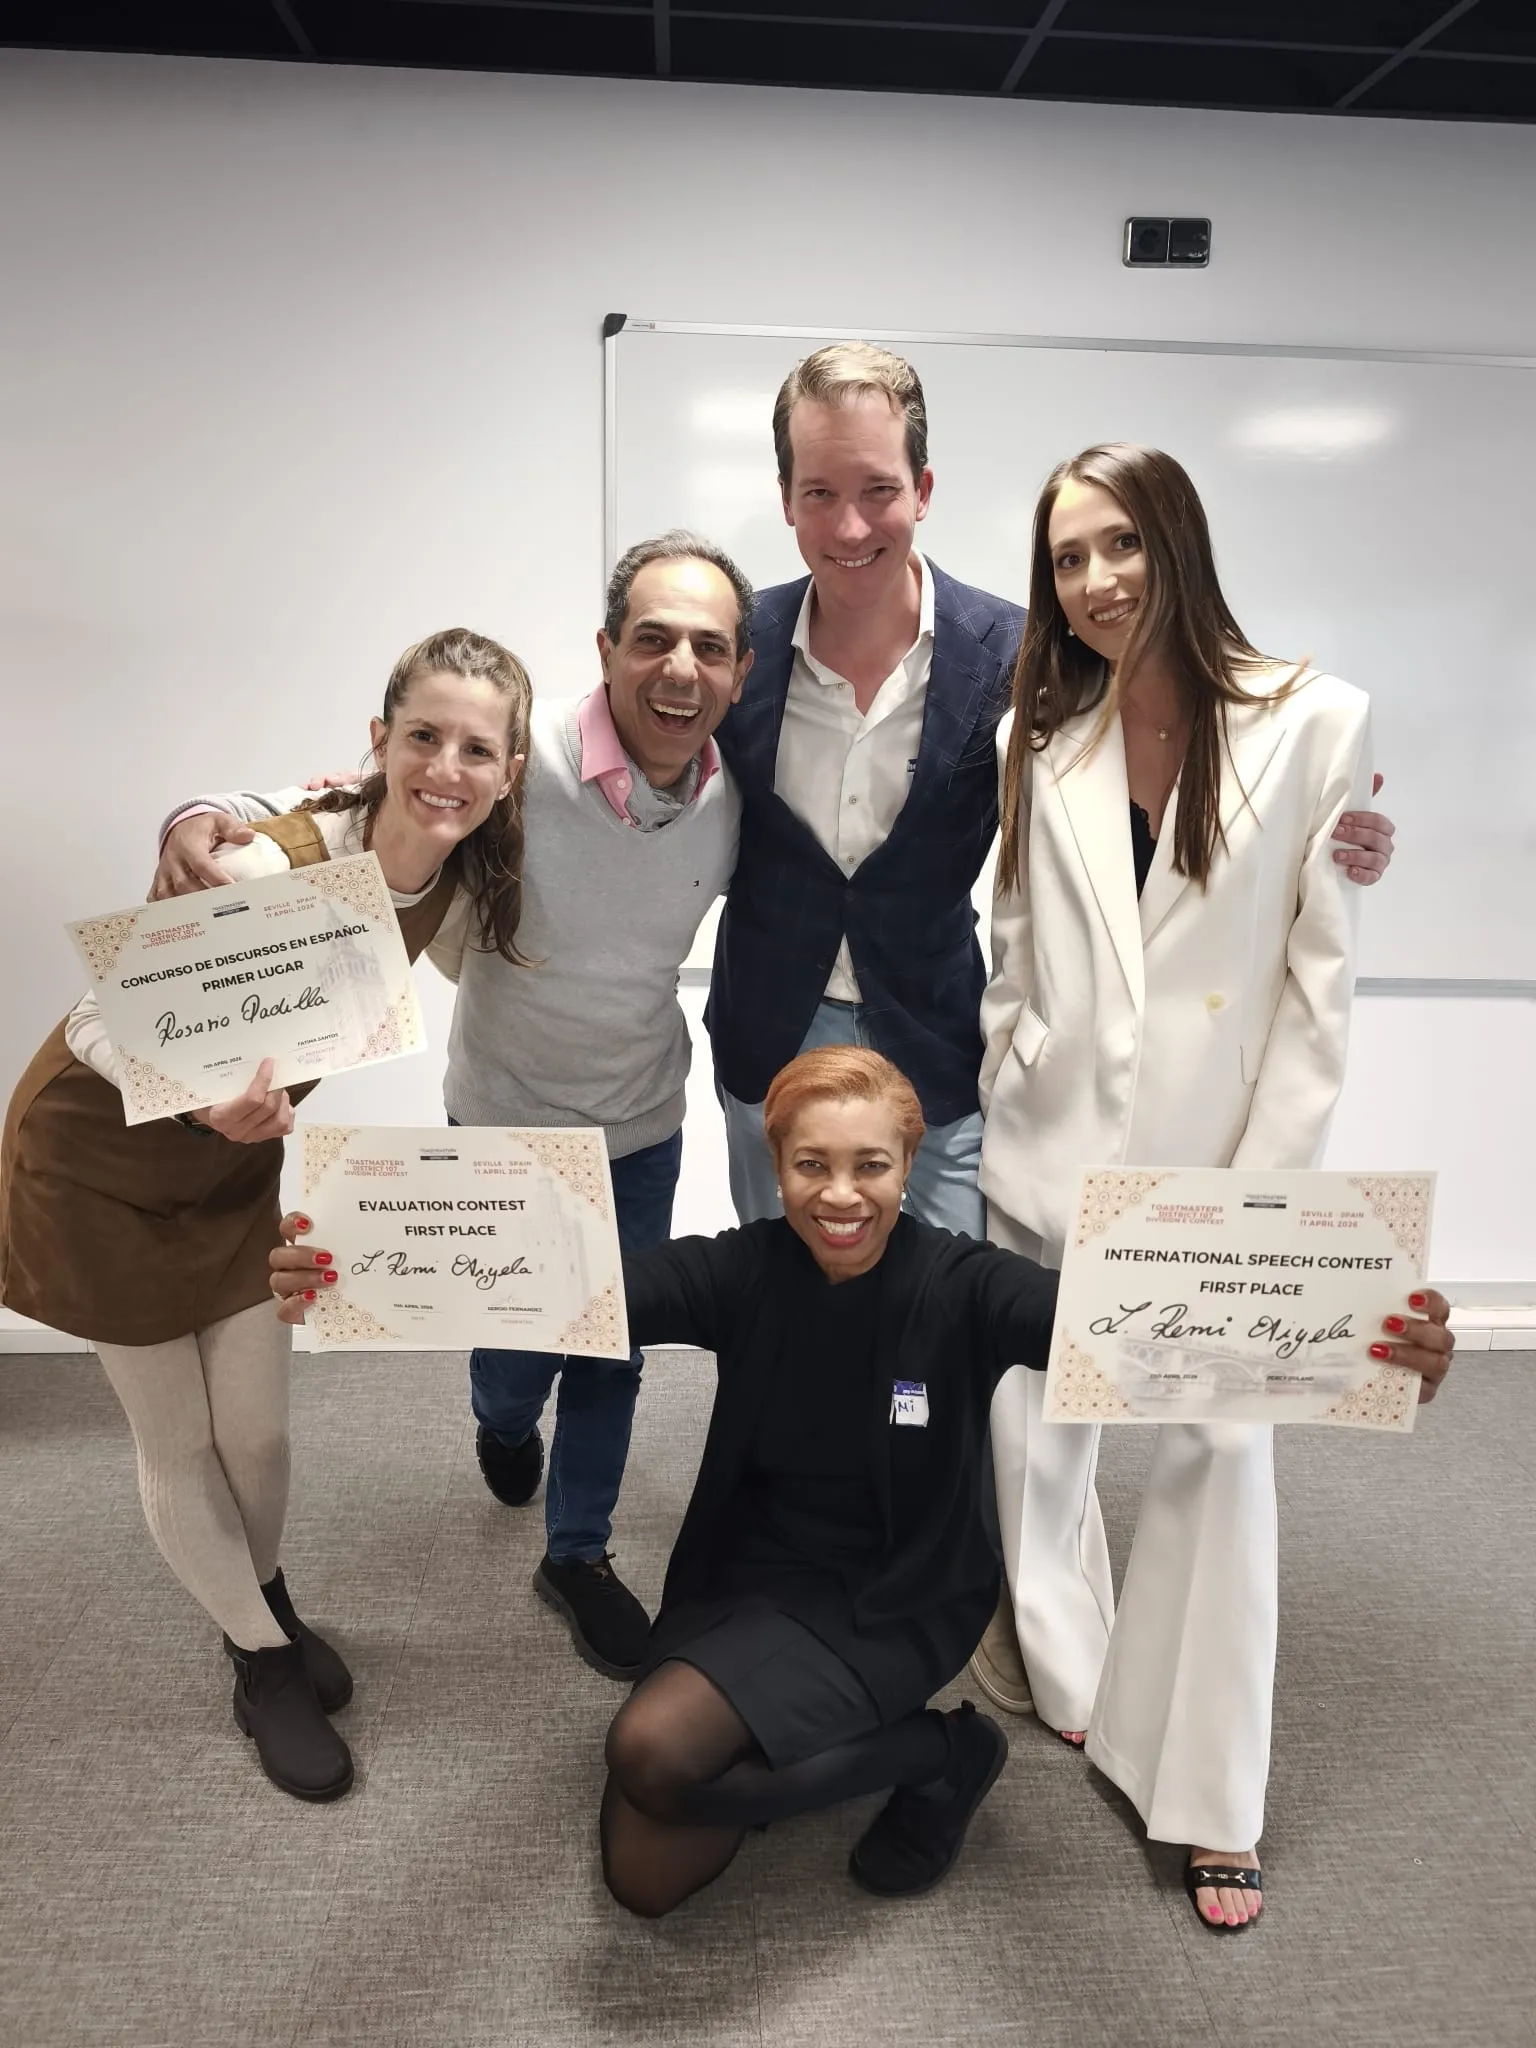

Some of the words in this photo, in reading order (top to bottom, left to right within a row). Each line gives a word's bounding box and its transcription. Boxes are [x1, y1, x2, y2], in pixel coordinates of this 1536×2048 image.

[263, 902, 290, 912] SEVILLE
[273, 908, 296, 918] APRIL
[140, 921, 201, 940] TOASTMASTERS
[150, 932, 181, 943] DISTRICT
[183, 928, 195, 936] 107
[177, 930, 206, 942] CONTEST
[121, 964, 193, 989] CONCURSO
[195, 960, 213, 972] DE
[214, 942, 288, 968] DISCURSOS
[289, 937, 308, 950] EN
[309, 923, 370, 945] ESPAÑOL
[202, 971, 256, 992] PRIMER
[257, 960, 305, 979] LUGAR
[241, 986, 330, 1024] Padilla
[345, 1158, 405, 1167] TOASTMASTERS
[359, 1200, 453, 1211] EVALUATION
[456, 1200, 526, 1211] CONTEST
[1151, 1203, 1224, 1213] TOASTMASTERS
[1158, 1211, 1198, 1219] DISTRICT
[1340, 1211, 1365, 1219] SPAIN
[1188, 1217, 1224, 1225] CONTEST
[1309, 1220, 1335, 1228] APRIL
[404, 1225, 445, 1236] FIRST
[449, 1225, 497, 1236] PLACE
[1104, 1248, 1243, 1266] INTERNATIONAL
[1247, 1254, 1314, 1268] SPEECH
[1317, 1256, 1393, 1270] CONTEST
[1200, 1281, 1247, 1295] FIRST
[1250, 1282, 1304, 1296] PLACE
